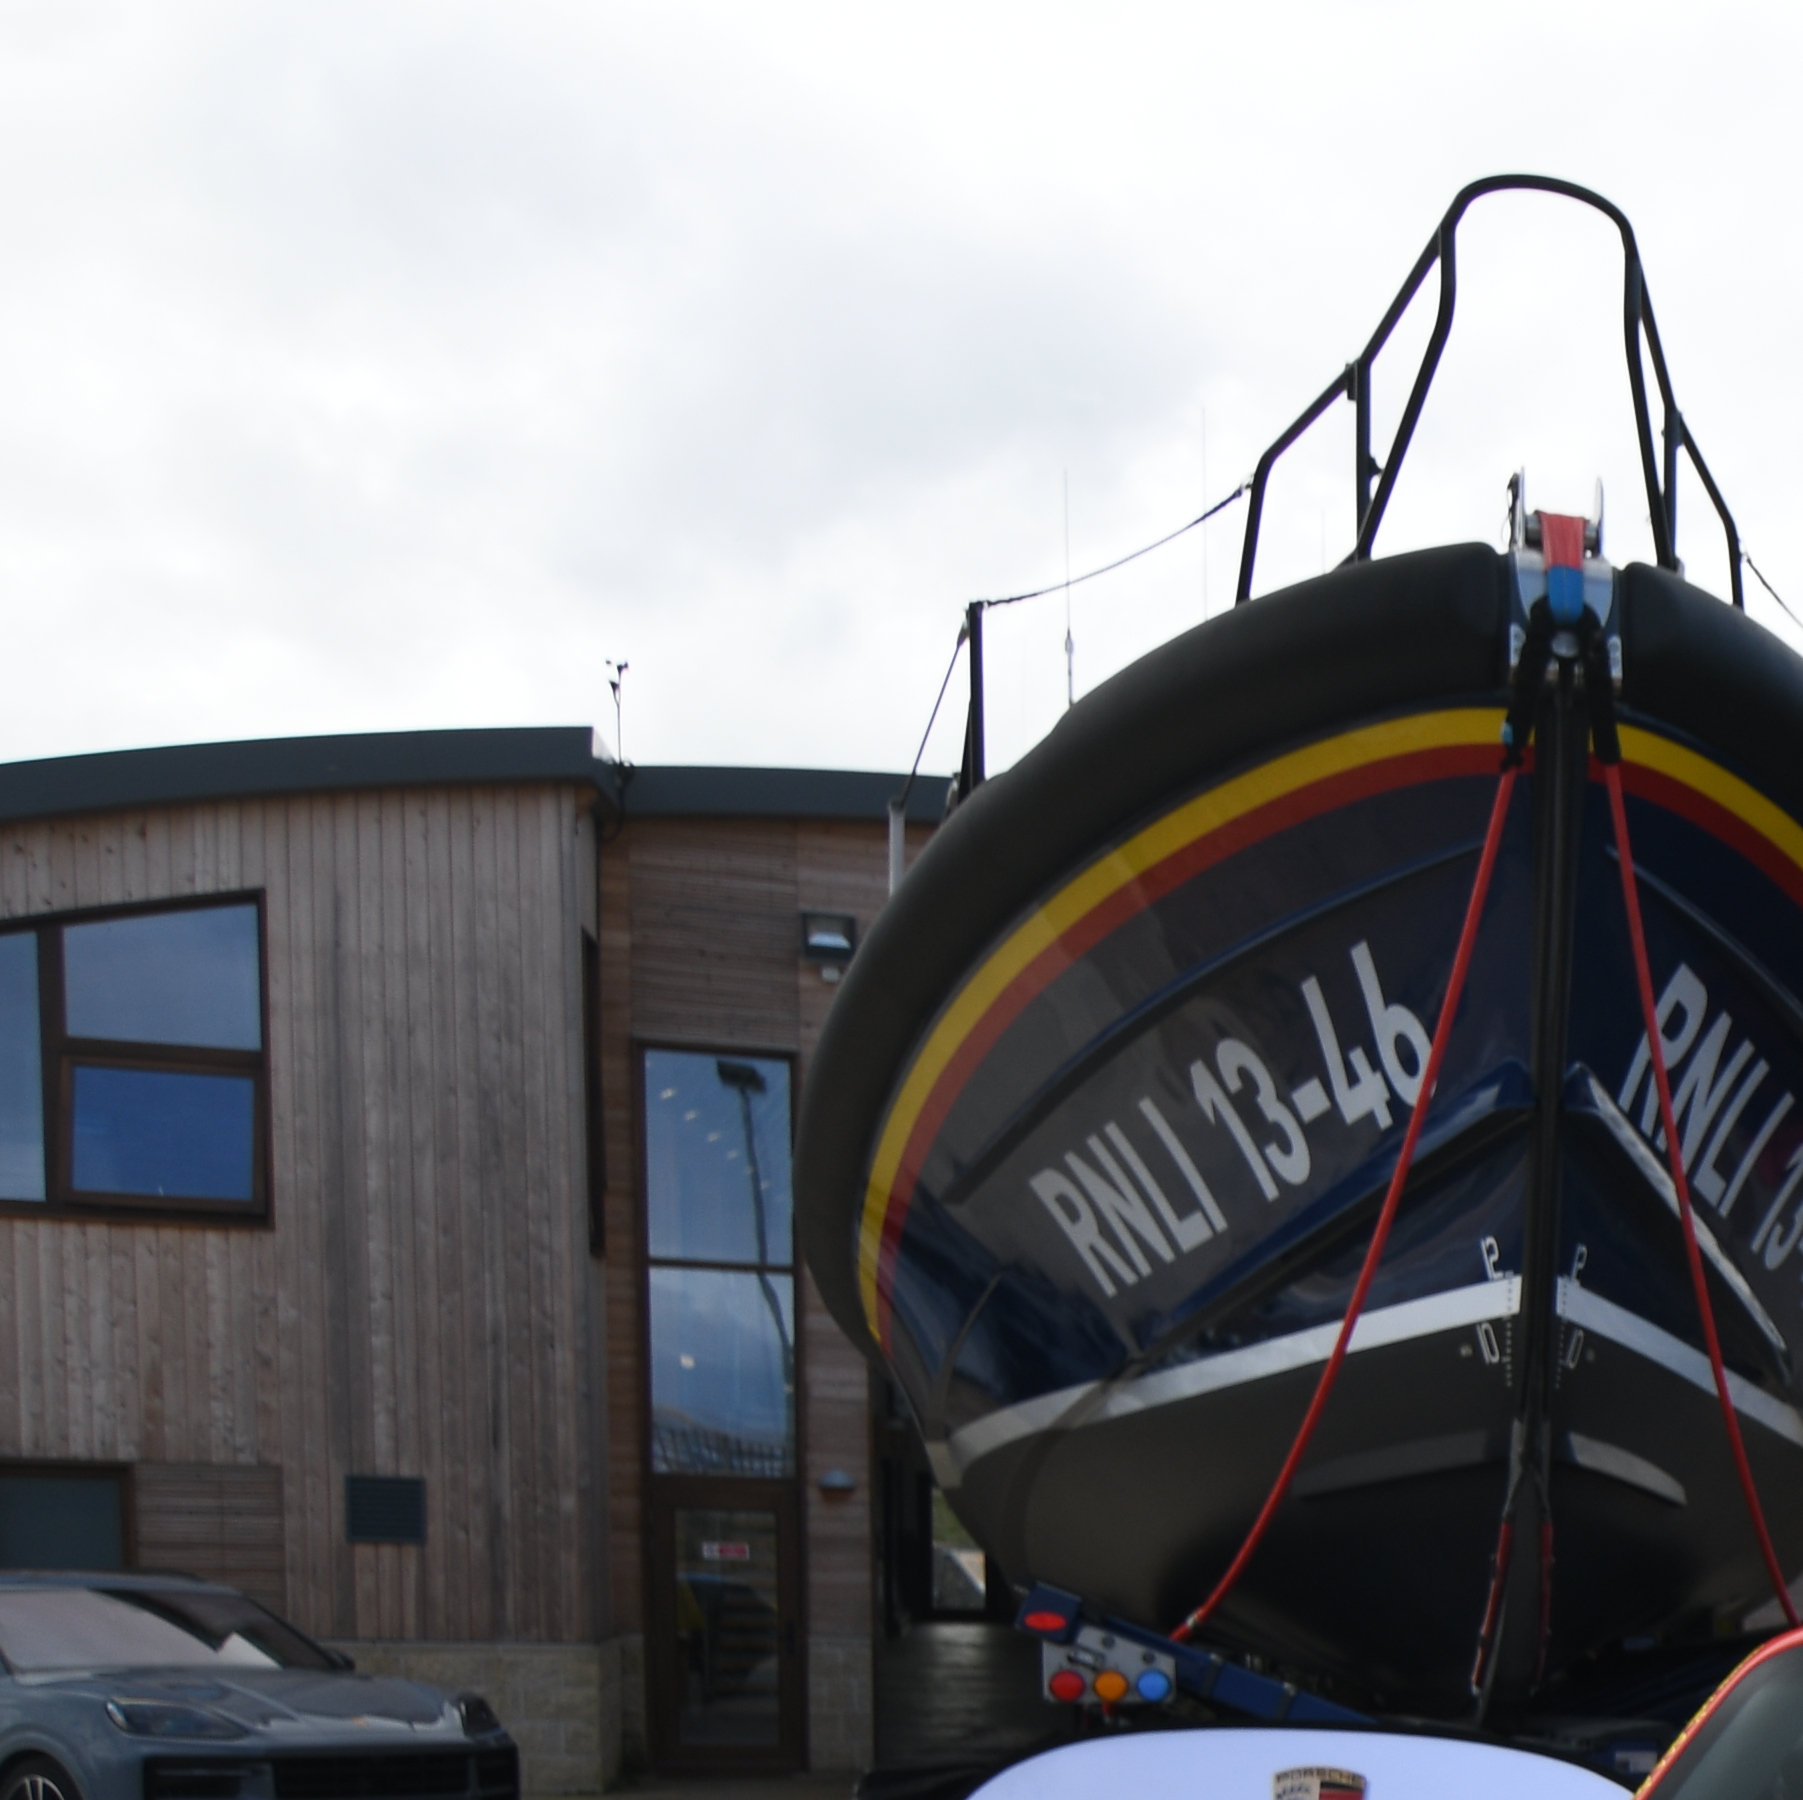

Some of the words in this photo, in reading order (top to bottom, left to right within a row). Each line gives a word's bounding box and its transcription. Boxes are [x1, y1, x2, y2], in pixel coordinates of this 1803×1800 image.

[1029, 1097, 1229, 1297] RNLI
[1199, 942, 1437, 1201] 13-46
[1618, 964, 1793, 1216] RNLI
